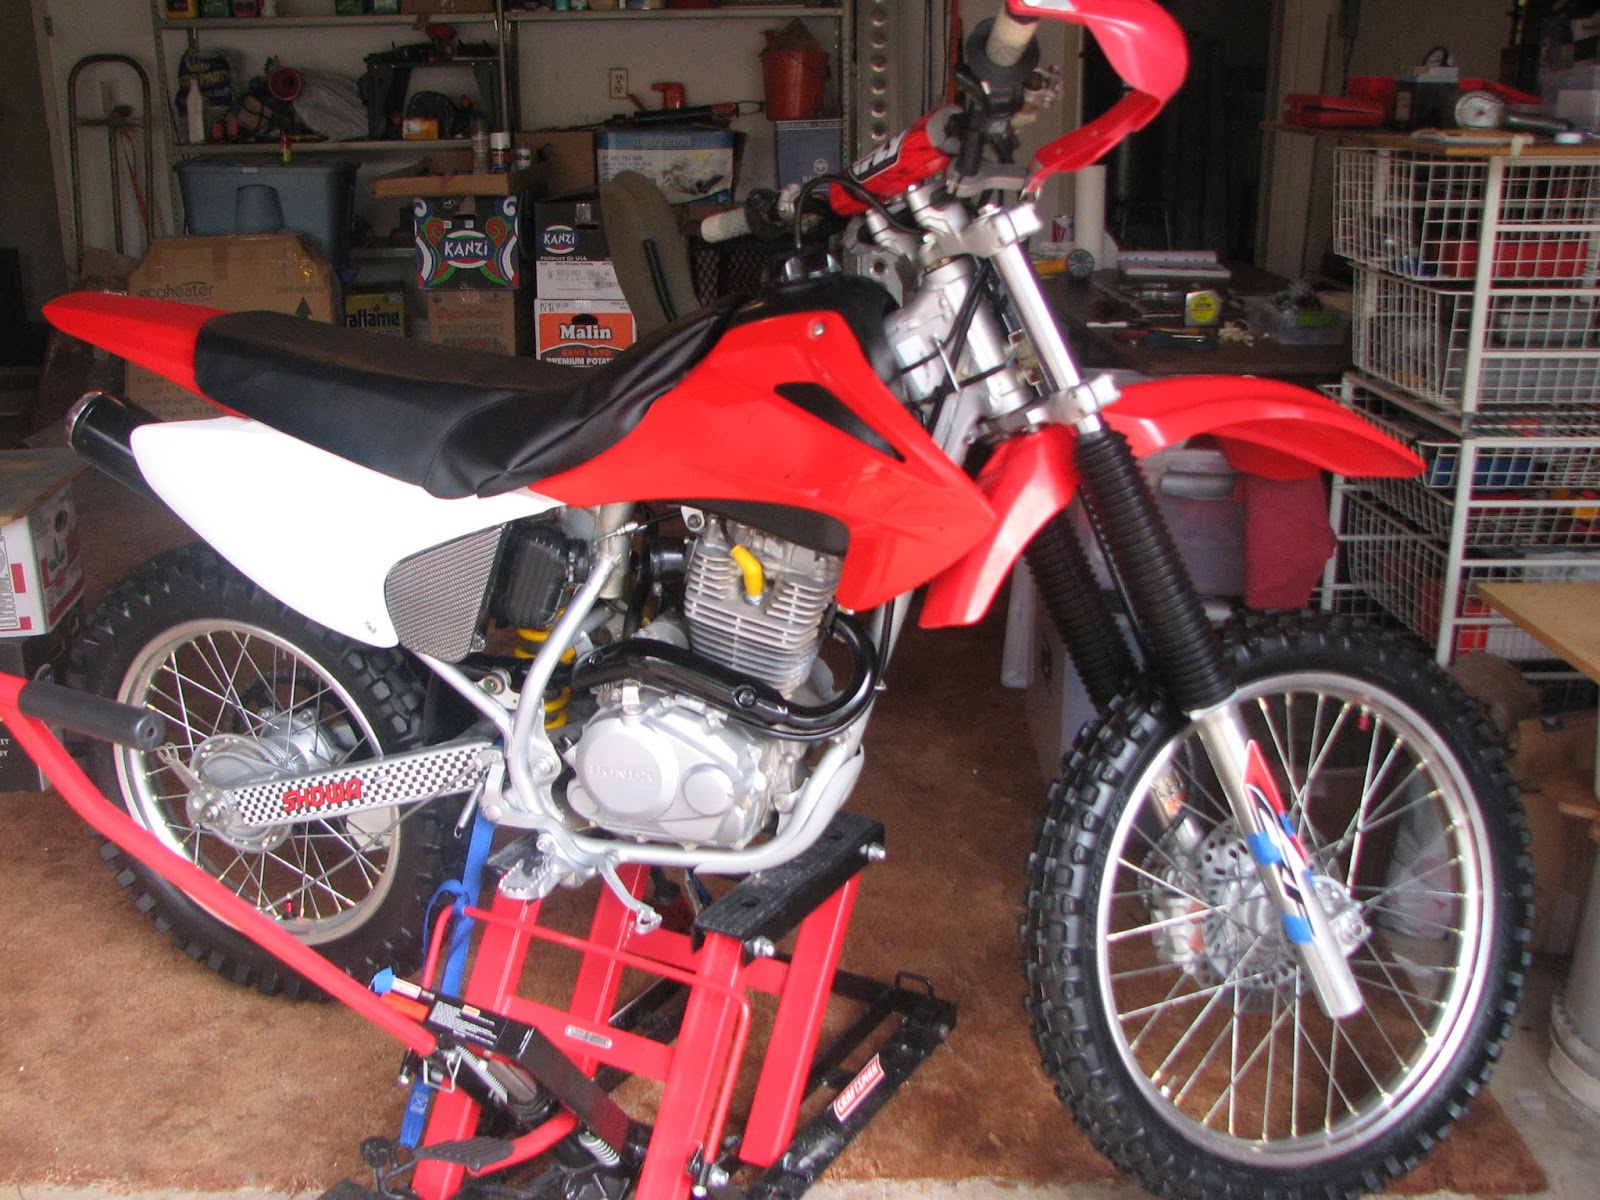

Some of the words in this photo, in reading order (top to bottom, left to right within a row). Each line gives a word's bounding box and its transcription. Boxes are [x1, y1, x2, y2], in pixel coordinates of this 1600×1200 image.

[139, 281, 215, 298] ecoheater
[559, 324, 612, 340] Malin
[546, 357, 585, 365] PREMIUM
[587, 357, 614, 365] POTAT
[282, 777, 362, 813] SHOWA
[836, 1060, 879, 1113] CRAFTSMAN
